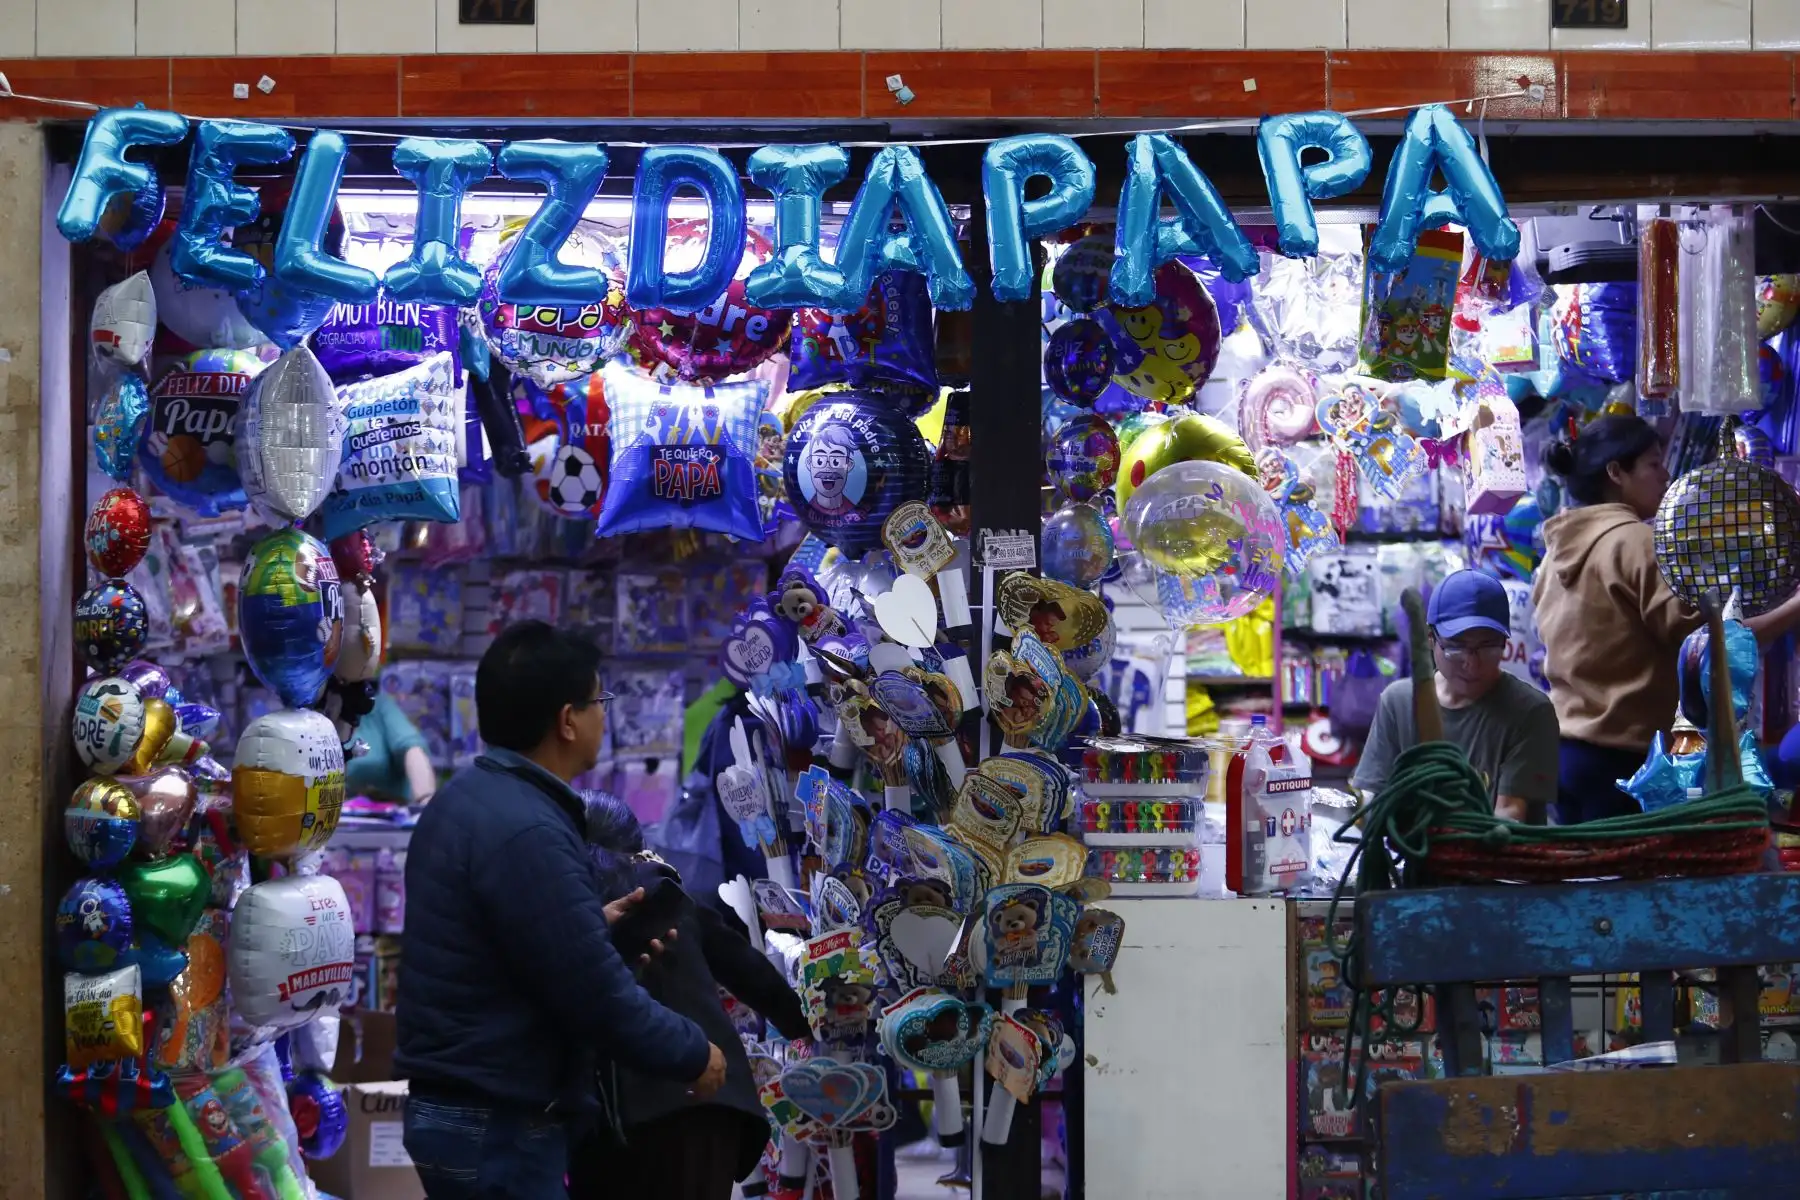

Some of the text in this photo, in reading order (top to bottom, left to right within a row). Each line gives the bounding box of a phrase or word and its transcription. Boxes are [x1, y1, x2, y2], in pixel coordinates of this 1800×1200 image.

[328, 332, 365, 346] GRACIAS
[379, 325, 422, 352] TODO
[167, 375, 212, 395] FELIZ
[347, 397, 418, 420] Guapetón
[368, 416, 383, 430] te
[570, 423, 611, 439] QATA
[351, 423, 420, 450] Queremos
[852, 418, 880, 454] padre
[368, 445, 393, 458] un
[659, 447, 713, 461] TE QUIERO
[351, 451, 428, 478] montón
[654, 454, 721, 500] PAPÁ
[1269, 779, 1310, 792] BOTIQUIN
[311, 896, 337, 911] Eres
[322, 911, 335, 922] un
